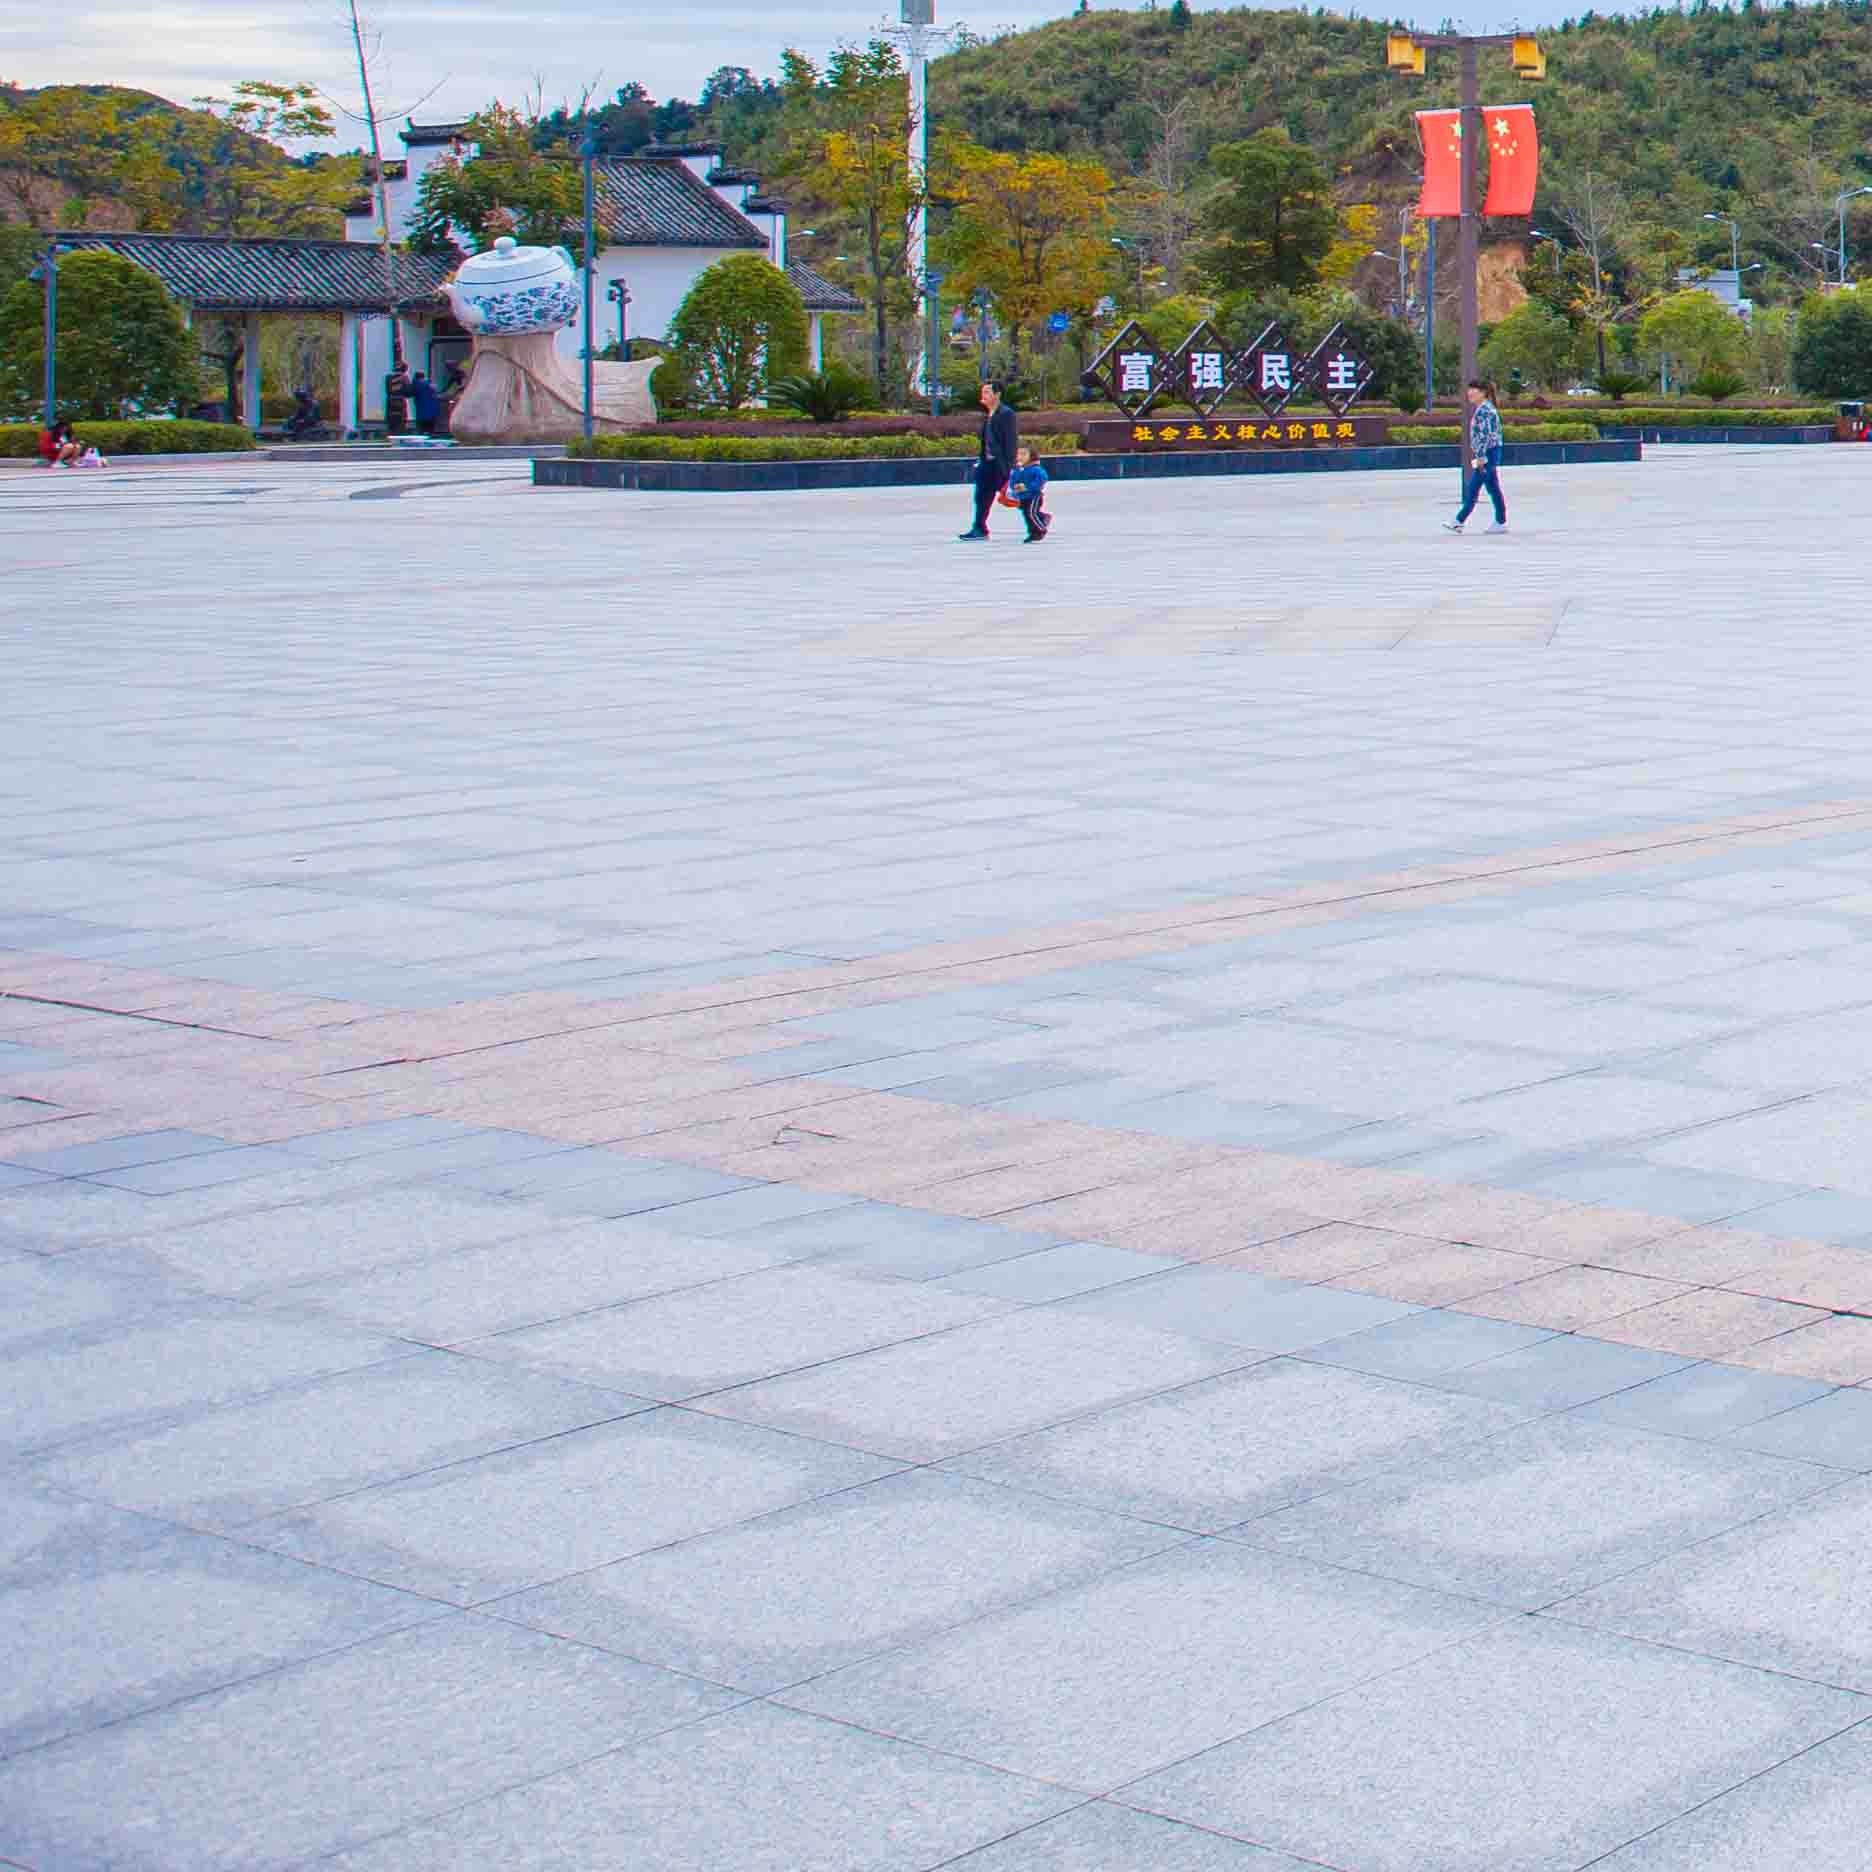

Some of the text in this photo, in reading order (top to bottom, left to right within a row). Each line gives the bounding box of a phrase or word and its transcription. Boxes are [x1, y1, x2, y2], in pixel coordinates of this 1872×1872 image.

[1120, 352, 1357, 391] 富强民主
[1132, 422, 1356, 441] 社会主义核心价值观
